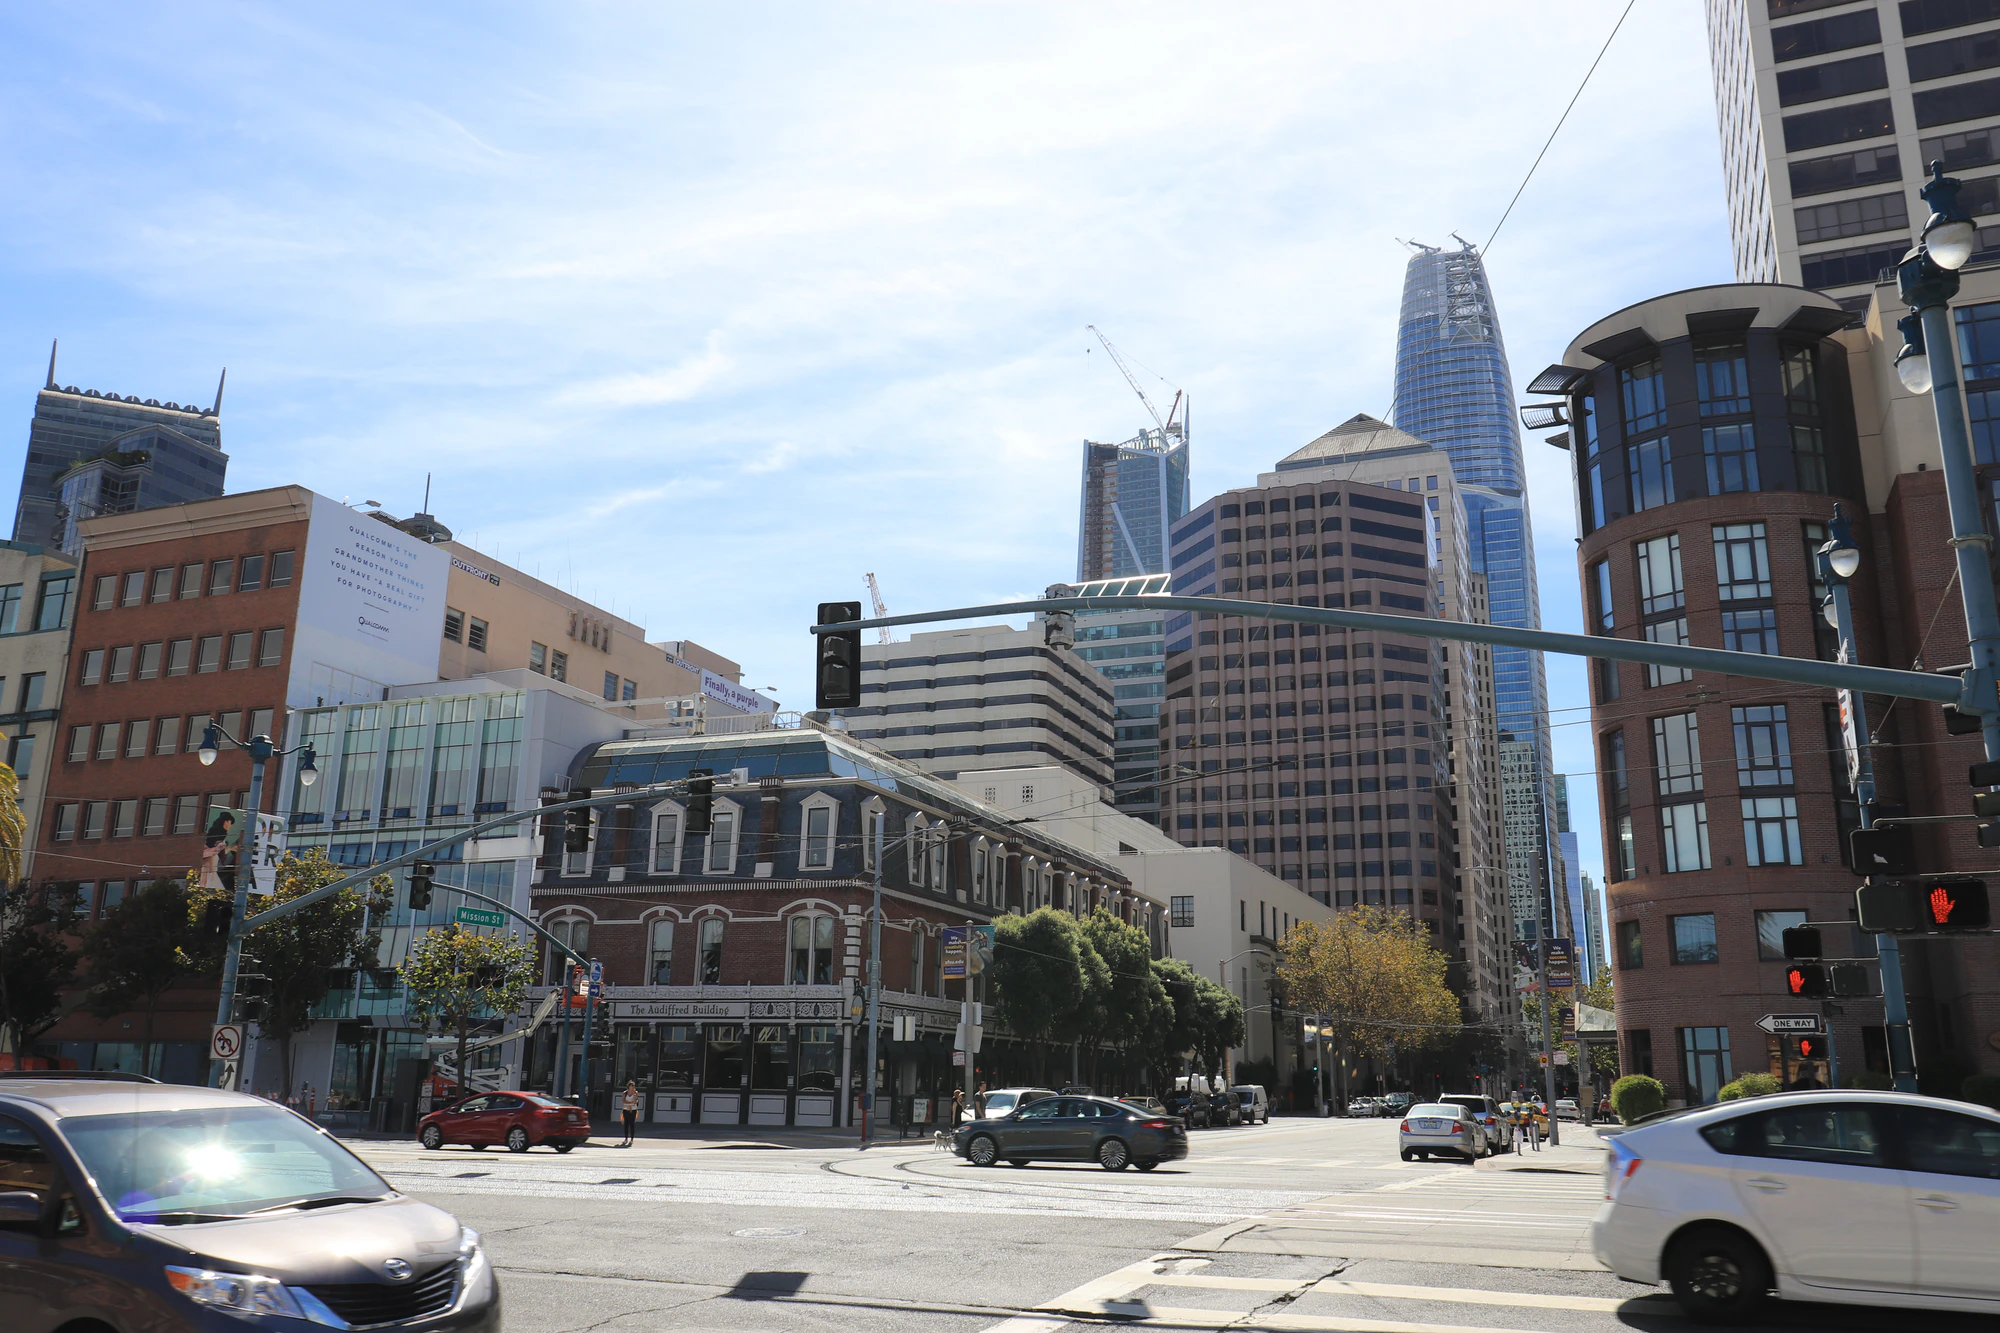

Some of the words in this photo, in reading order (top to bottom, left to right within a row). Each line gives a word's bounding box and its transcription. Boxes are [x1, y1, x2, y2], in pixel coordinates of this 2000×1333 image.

[349, 525, 400, 553] QUALCOMM'S
[403, 549, 417, 560] THE
[355, 542, 386, 559] REASON
[389, 557, 409, 570] YOUR
[330, 560, 347, 571] YOU
[350, 568, 371, 581] HAVE
[386, 583, 405, 595] REAL
[408, 592, 425, 603] GIFT
[334, 547, 394, 577] GRANDMOTHER
[397, 573, 424, 590] THINKS
[337, 577, 353, 588] FOR
[452, 558, 488, 580] OUTFRONT
[704, 676, 730, 698] Finally,
[731, 690, 736, 698] a
[736, 693, 759, 708] purple
[460, 910, 490, 923] Mission
[491, 915, 501, 925] St
[630, 1004, 645, 1016] The
[647, 1004, 689, 1016] Audiffred
[692, 1004, 730, 1017] Building
